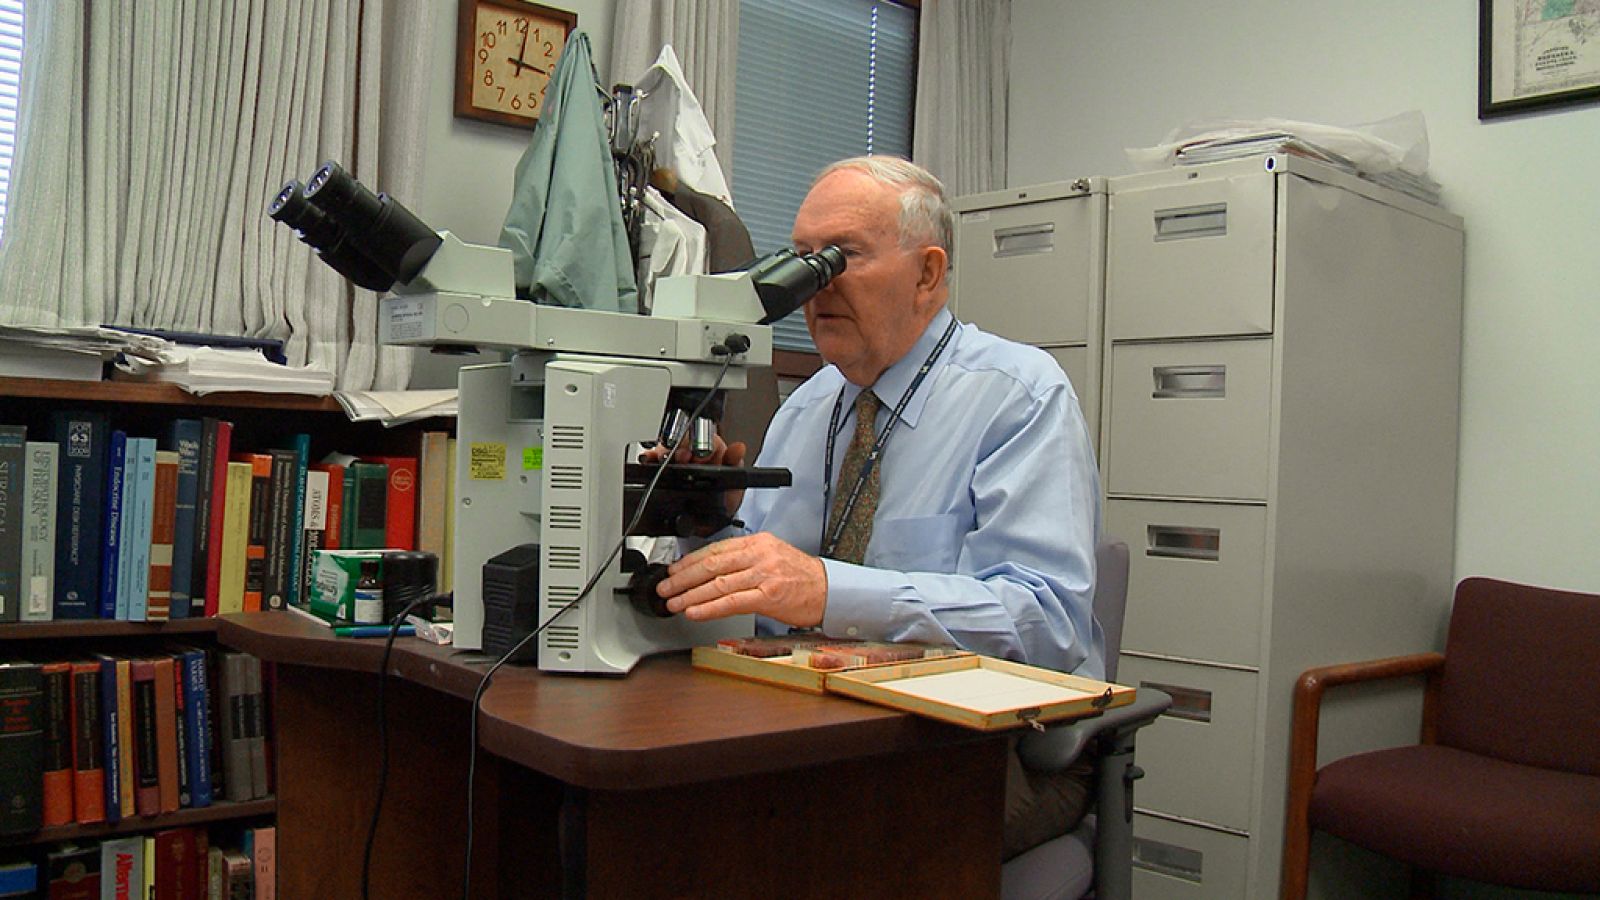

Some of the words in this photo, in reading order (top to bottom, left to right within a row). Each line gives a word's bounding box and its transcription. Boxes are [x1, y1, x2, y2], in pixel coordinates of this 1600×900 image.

[497, 20, 507, 36] 11
[514, 17, 528, 34] 12
[481, 31, 496, 49] 10
[534, 28, 540, 42] 1
[478, 48, 489, 64] 9
[543, 41, 553, 57] 2
[484, 69, 494, 86] 8
[496, 86, 505, 102] 7
[511, 94, 522, 110] 6
[528, 92, 537, 109] 5
[39, 451, 51, 542] HISTOPATHOLOGY
[111, 466, 122, 510] Endocrine
[312, 488, 322, 519] ATOMS
[109, 511, 119, 546] Diseases
